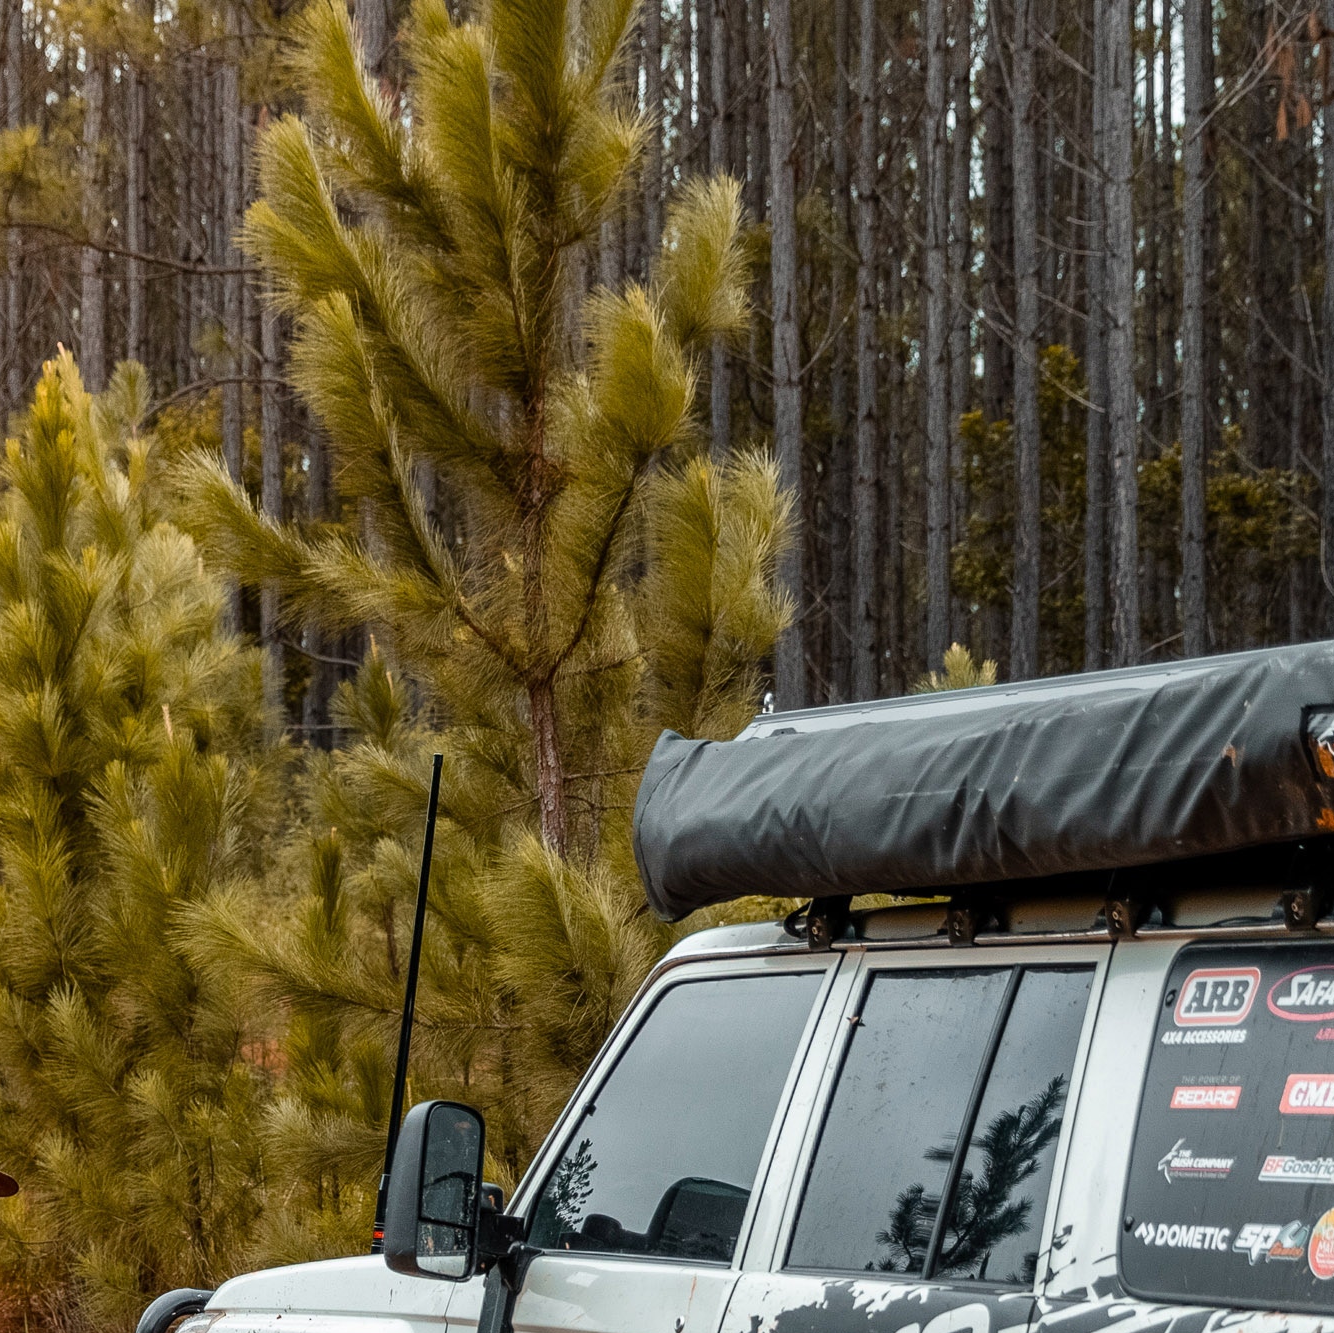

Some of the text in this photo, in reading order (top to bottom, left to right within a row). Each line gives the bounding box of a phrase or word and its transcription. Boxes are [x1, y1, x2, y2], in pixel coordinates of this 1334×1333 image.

[1183, 979, 1250, 1014] ARB
[1183, 1029, 1247, 1044] ACCESSORIES
[1181, 1075, 1196, 1084] THE
[1198, 1075, 1227, 1085] POWER
[1174, 1089, 1236, 1106] REDARC
[1170, 1157, 1234, 1169] BUSH COMPANY
[1155, 1223, 1230, 1251] DOMETIC
